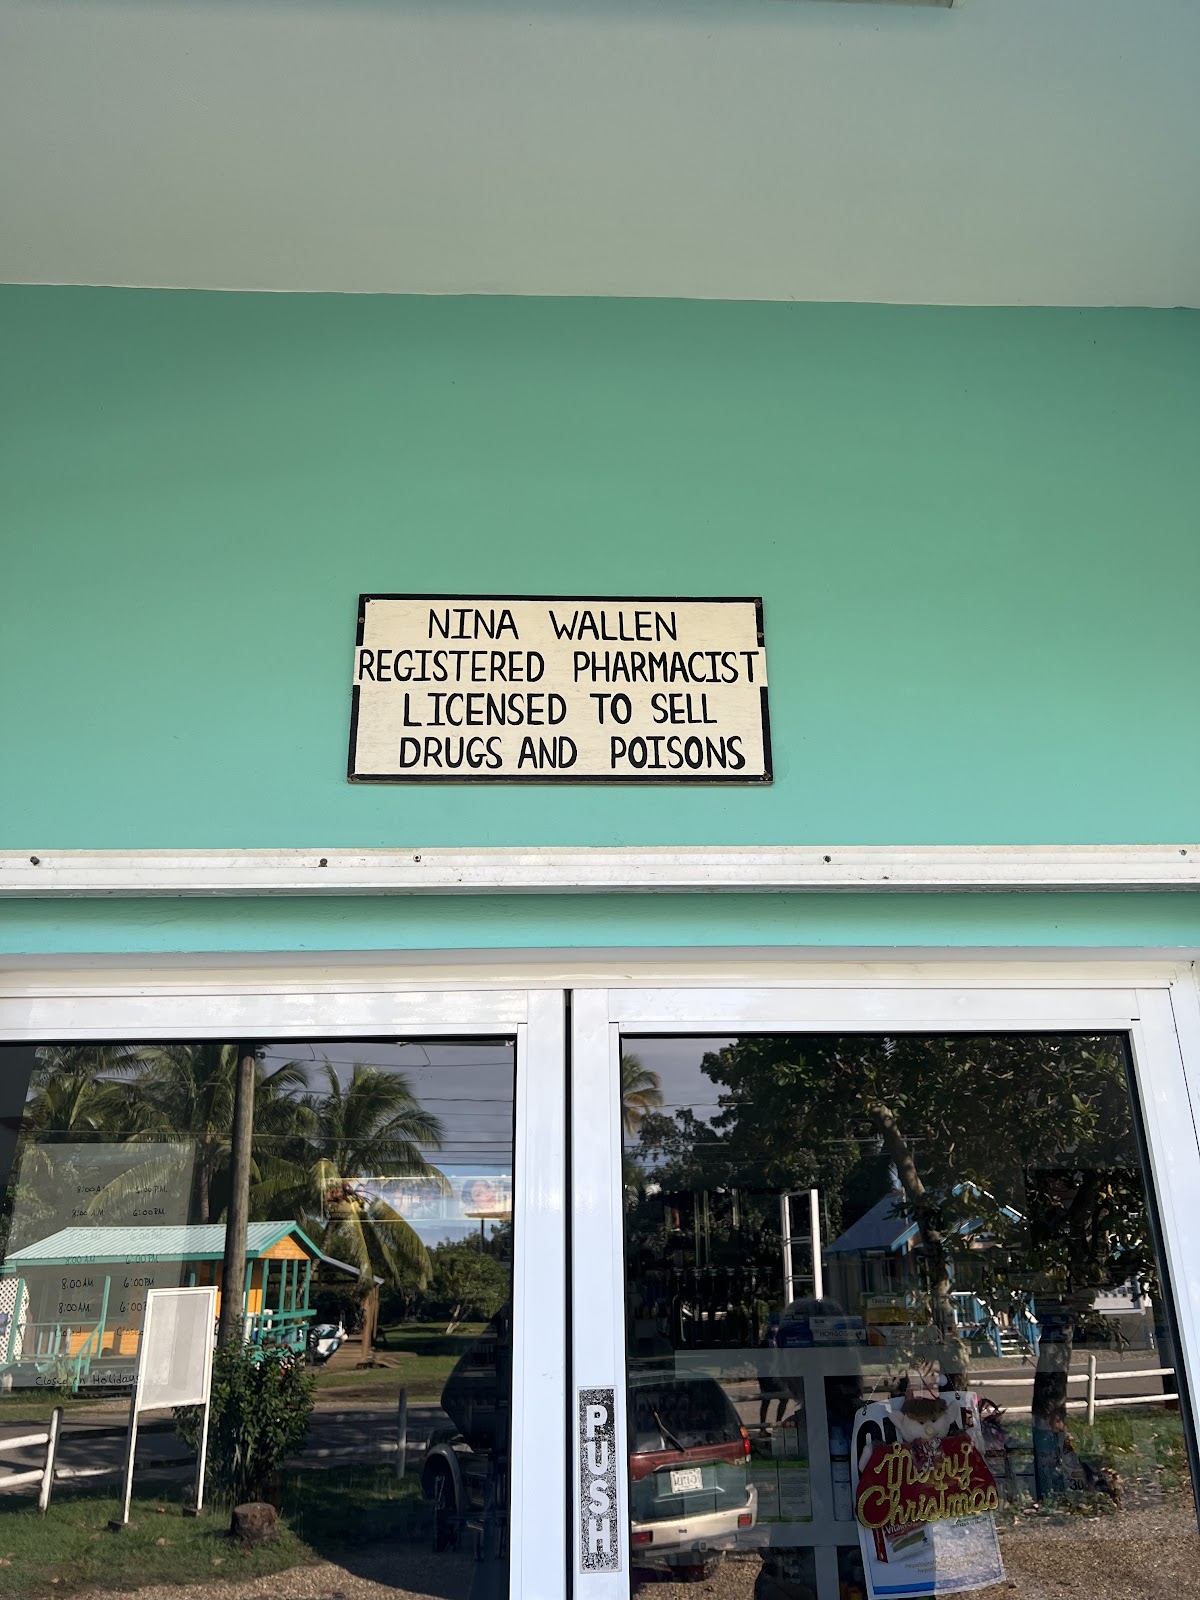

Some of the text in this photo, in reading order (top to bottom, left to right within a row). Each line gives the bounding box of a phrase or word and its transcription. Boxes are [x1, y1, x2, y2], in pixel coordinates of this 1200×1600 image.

[428, 609, 677, 641] NINA WALLEN
[358, 649, 759, 683] REGISTERED PHARMACIST
[403, 693, 718, 726] LICENSED TO SELL
[399, 736, 746, 769] DRUGS AND POISONS
[585, 1404, 613, 1553] PUSH
[857, 1477, 999, 1529] Christmas
